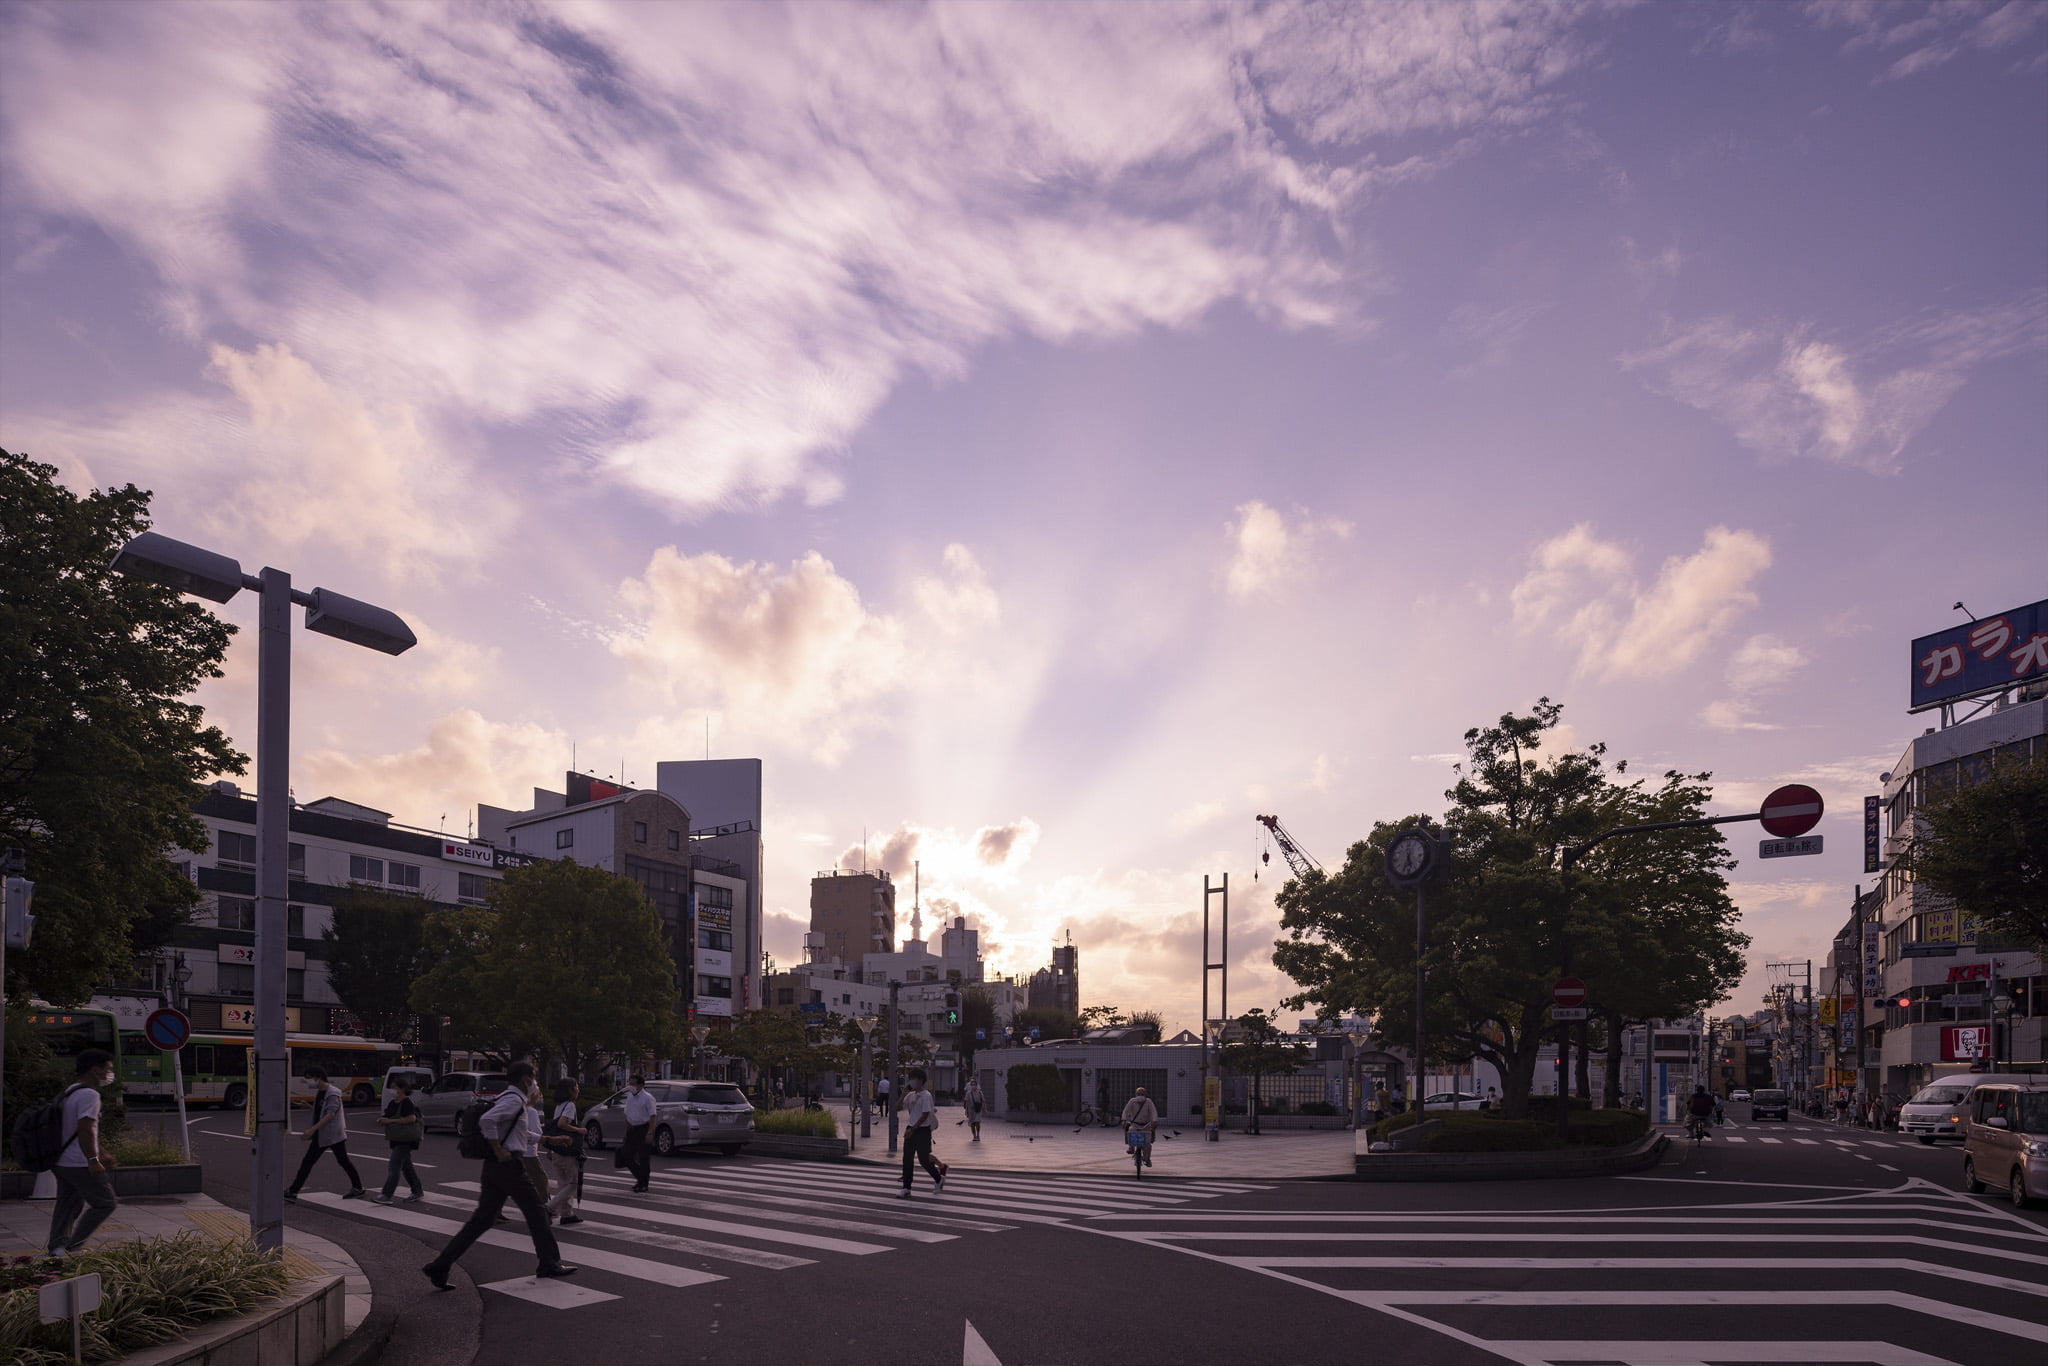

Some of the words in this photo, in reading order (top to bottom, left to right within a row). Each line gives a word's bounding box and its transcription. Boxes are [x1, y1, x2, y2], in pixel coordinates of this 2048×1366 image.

[1920, 617, 2048, 686] カラオ
[1867, 798, 1877, 845] カラオケ
[456, 847, 491, 861] SEIYU
[1764, 840, 1817, 855] 自転車を除く
